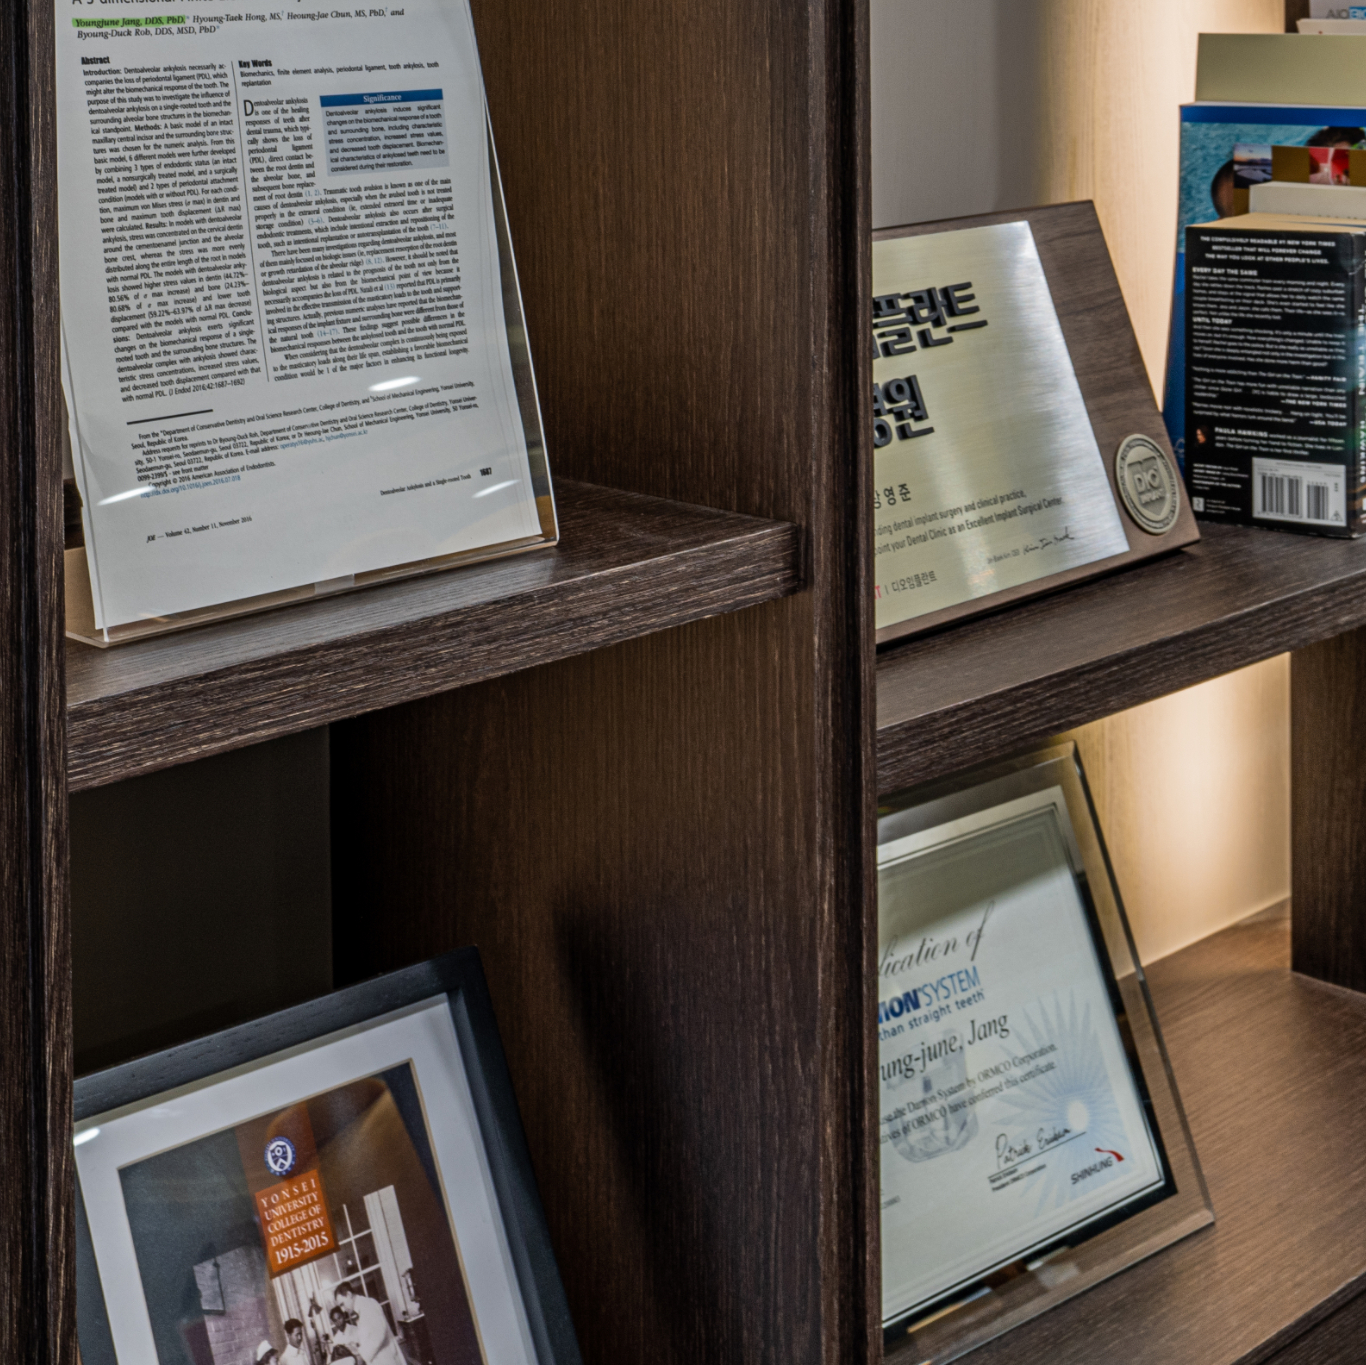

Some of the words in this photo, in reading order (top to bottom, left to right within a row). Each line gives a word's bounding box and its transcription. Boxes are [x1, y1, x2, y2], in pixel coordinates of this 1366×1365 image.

[75, 18, 120, 28] Youngjune
[121, 17, 143, 28] Jang,
[145, 16, 165, 26] DDS,
[81, 56, 110, 66] Abstract
[239, 60, 251, 69] Key
[252, 58, 272, 68] Words
[363, 94, 402, 103] Significance
[873, 281, 989, 360] 플란트
[1358, 344, 1366, 396] TRAIN
[893, 517, 915, 532] dental
[915, 512, 939, 527] implant
[939, 506, 963, 521] surgery
[964, 502, 976, 513] and
[977, 494, 999, 509] clinical
[999, 488, 1027, 504] practice,
[891, 539, 906, 552] your
[907, 532, 929, 547] Dental
[929, 527, 947, 542] Clinic
[948, 526, 957, 535] as
[957, 524, 965, 533] an
[965, 515, 995, 530] Excellent
[995, 508, 1018, 523] Implant
[1018, 500, 1043, 516] Surgical
[891, 570, 937, 594] 디오임플란트
[908, 1004, 953, 1030] straight
[955, 988, 984, 1010] teeth
[967, 1014, 1010, 1046] Jang
[1070, 1156, 1114, 1186] SHINHUNG
[261, 1178, 316, 1208] YONSEI
[264, 1192, 319, 1221] UNIVERSITY
[267, 1208, 309, 1234] COLLEGE
[309, 1204, 322, 1217] OF
[271, 1216, 325, 1247] DENTISTRY
[275, 1231, 329, 1264] 1915-2015
